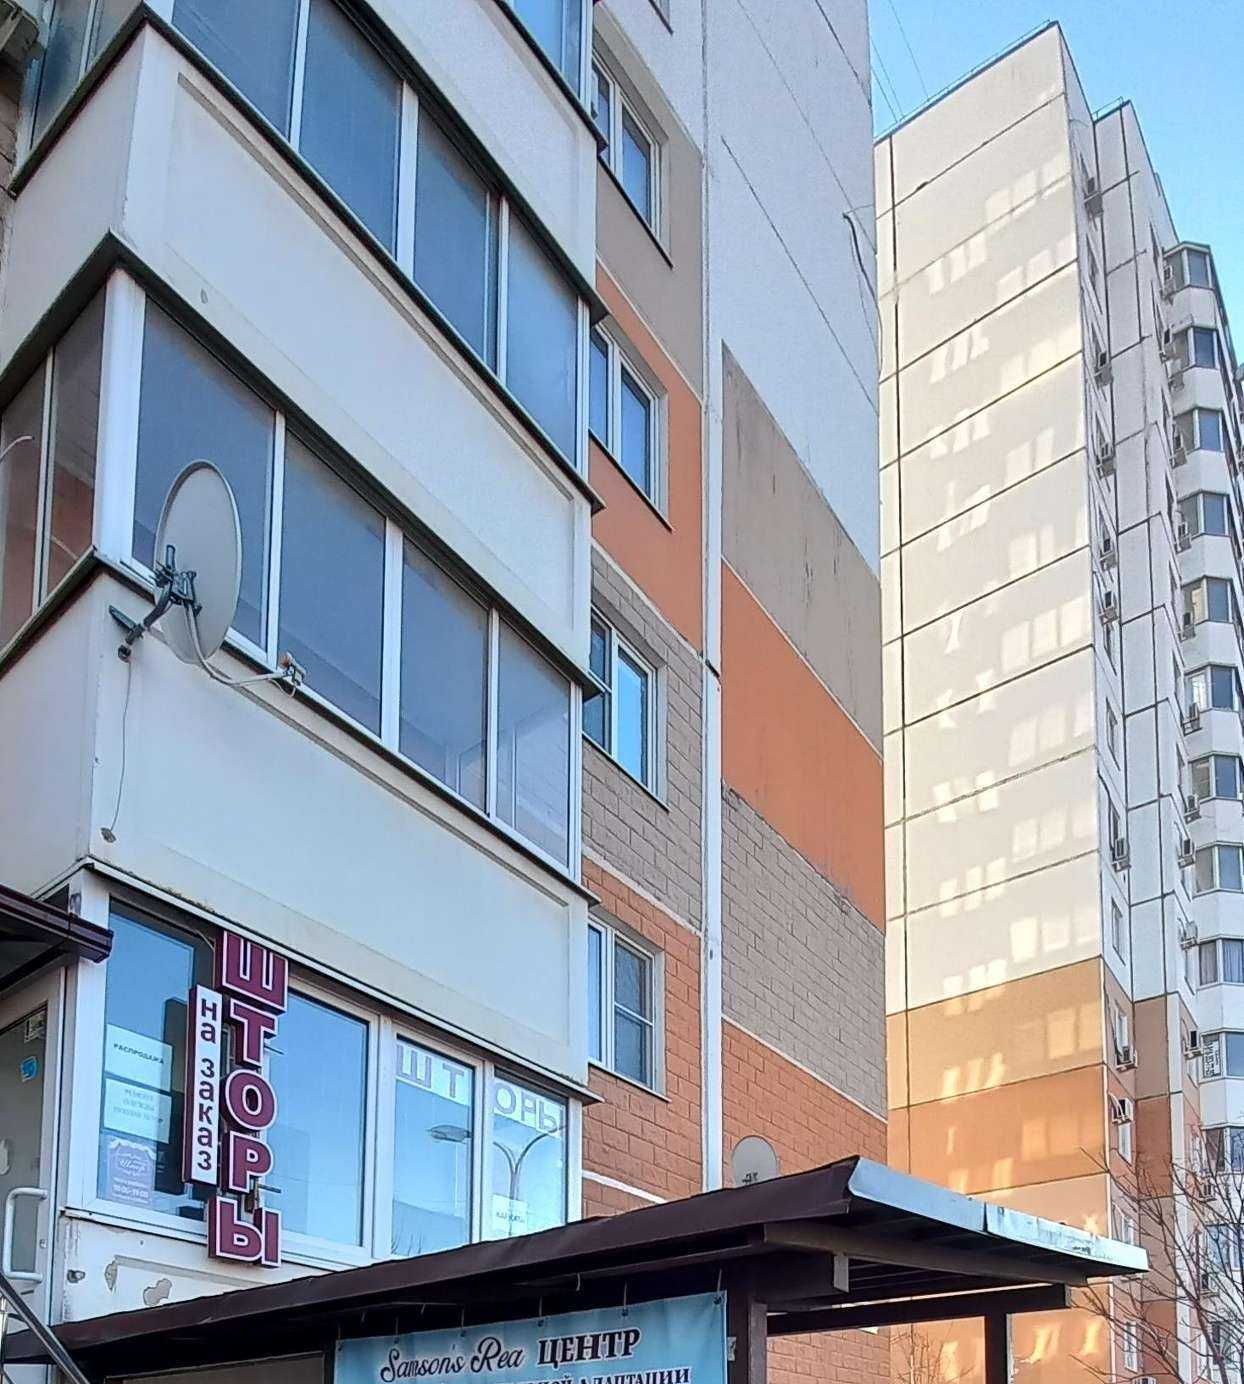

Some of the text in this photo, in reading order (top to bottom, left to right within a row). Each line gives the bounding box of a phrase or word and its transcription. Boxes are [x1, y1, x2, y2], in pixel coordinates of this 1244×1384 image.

[197, 1058, 217, 1171] заказ
[212, 929, 288, 1267] ШТОРЫ
[470, 1336, 524, 1373] Rea
[538, 1329, 641, 1369] ЦЕНТР
